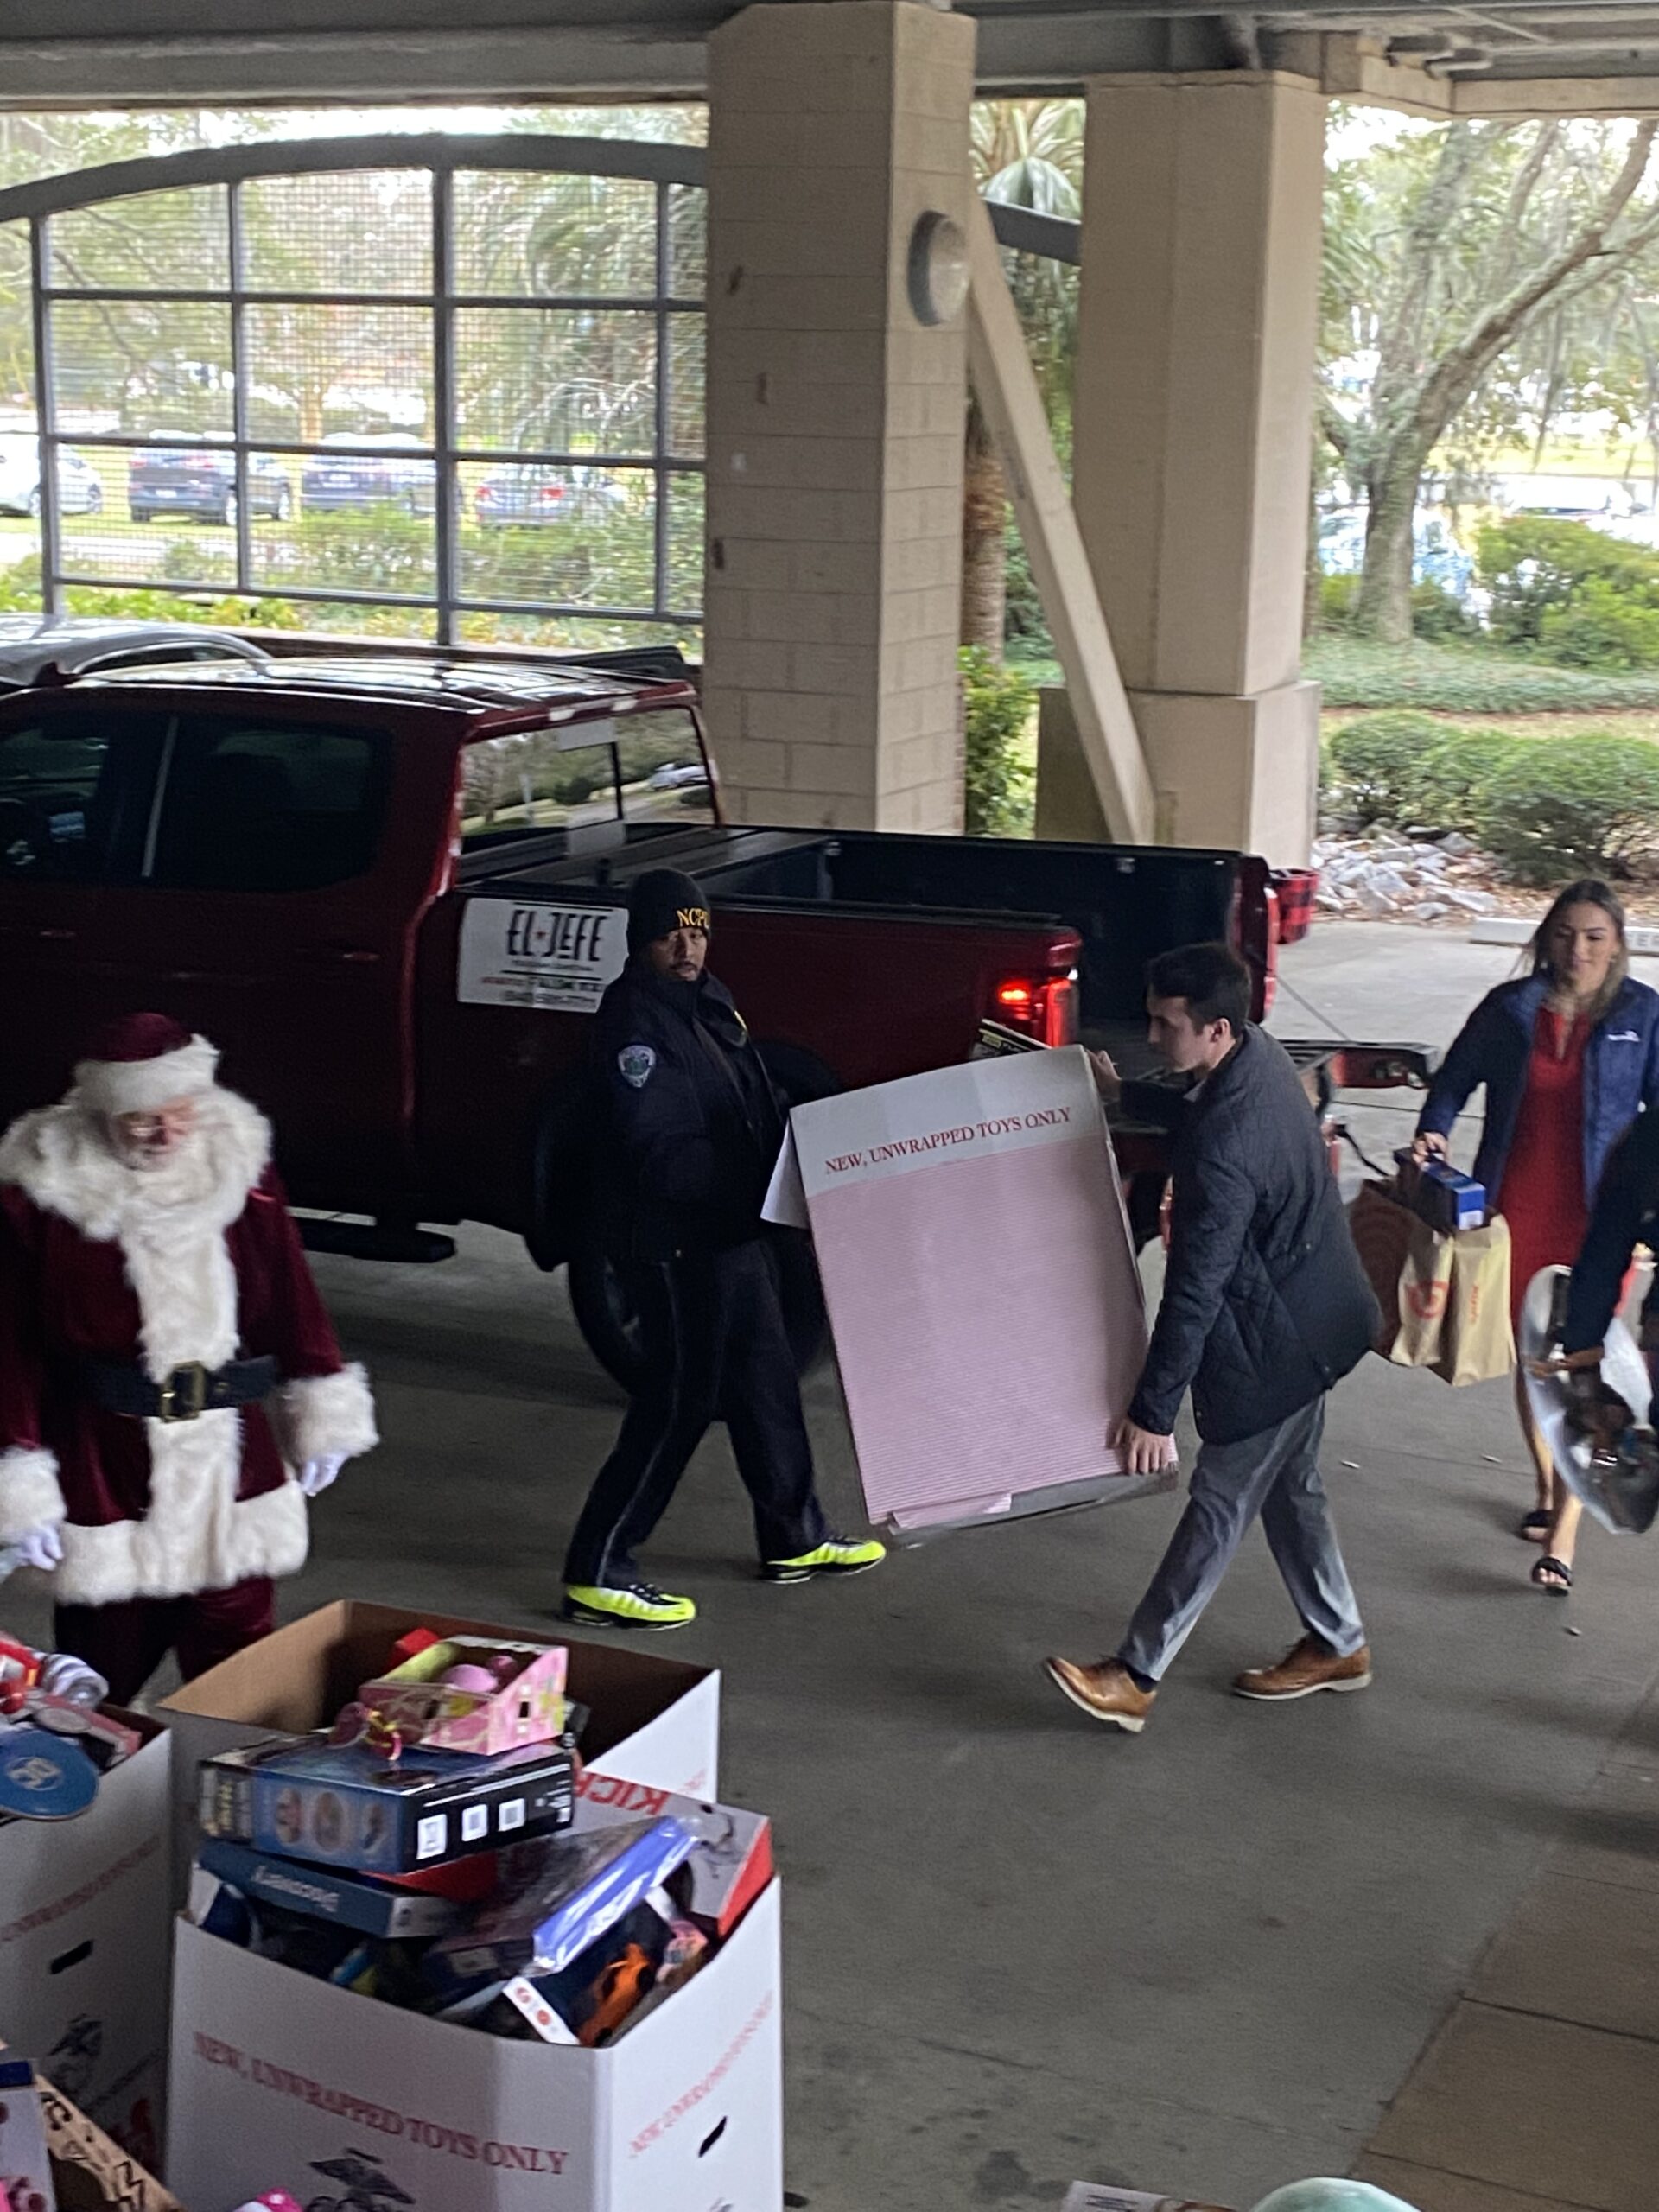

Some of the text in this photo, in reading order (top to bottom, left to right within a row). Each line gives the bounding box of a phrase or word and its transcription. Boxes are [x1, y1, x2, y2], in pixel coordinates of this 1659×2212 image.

[507, 909, 608, 962] EL JEFE
[825, 1106, 1071, 1174] NEW, UNWRAPPED TOYS ONLY
[404, 2117, 481, 2159] TOYS
[481, 2140, 569, 2176] ONLY
